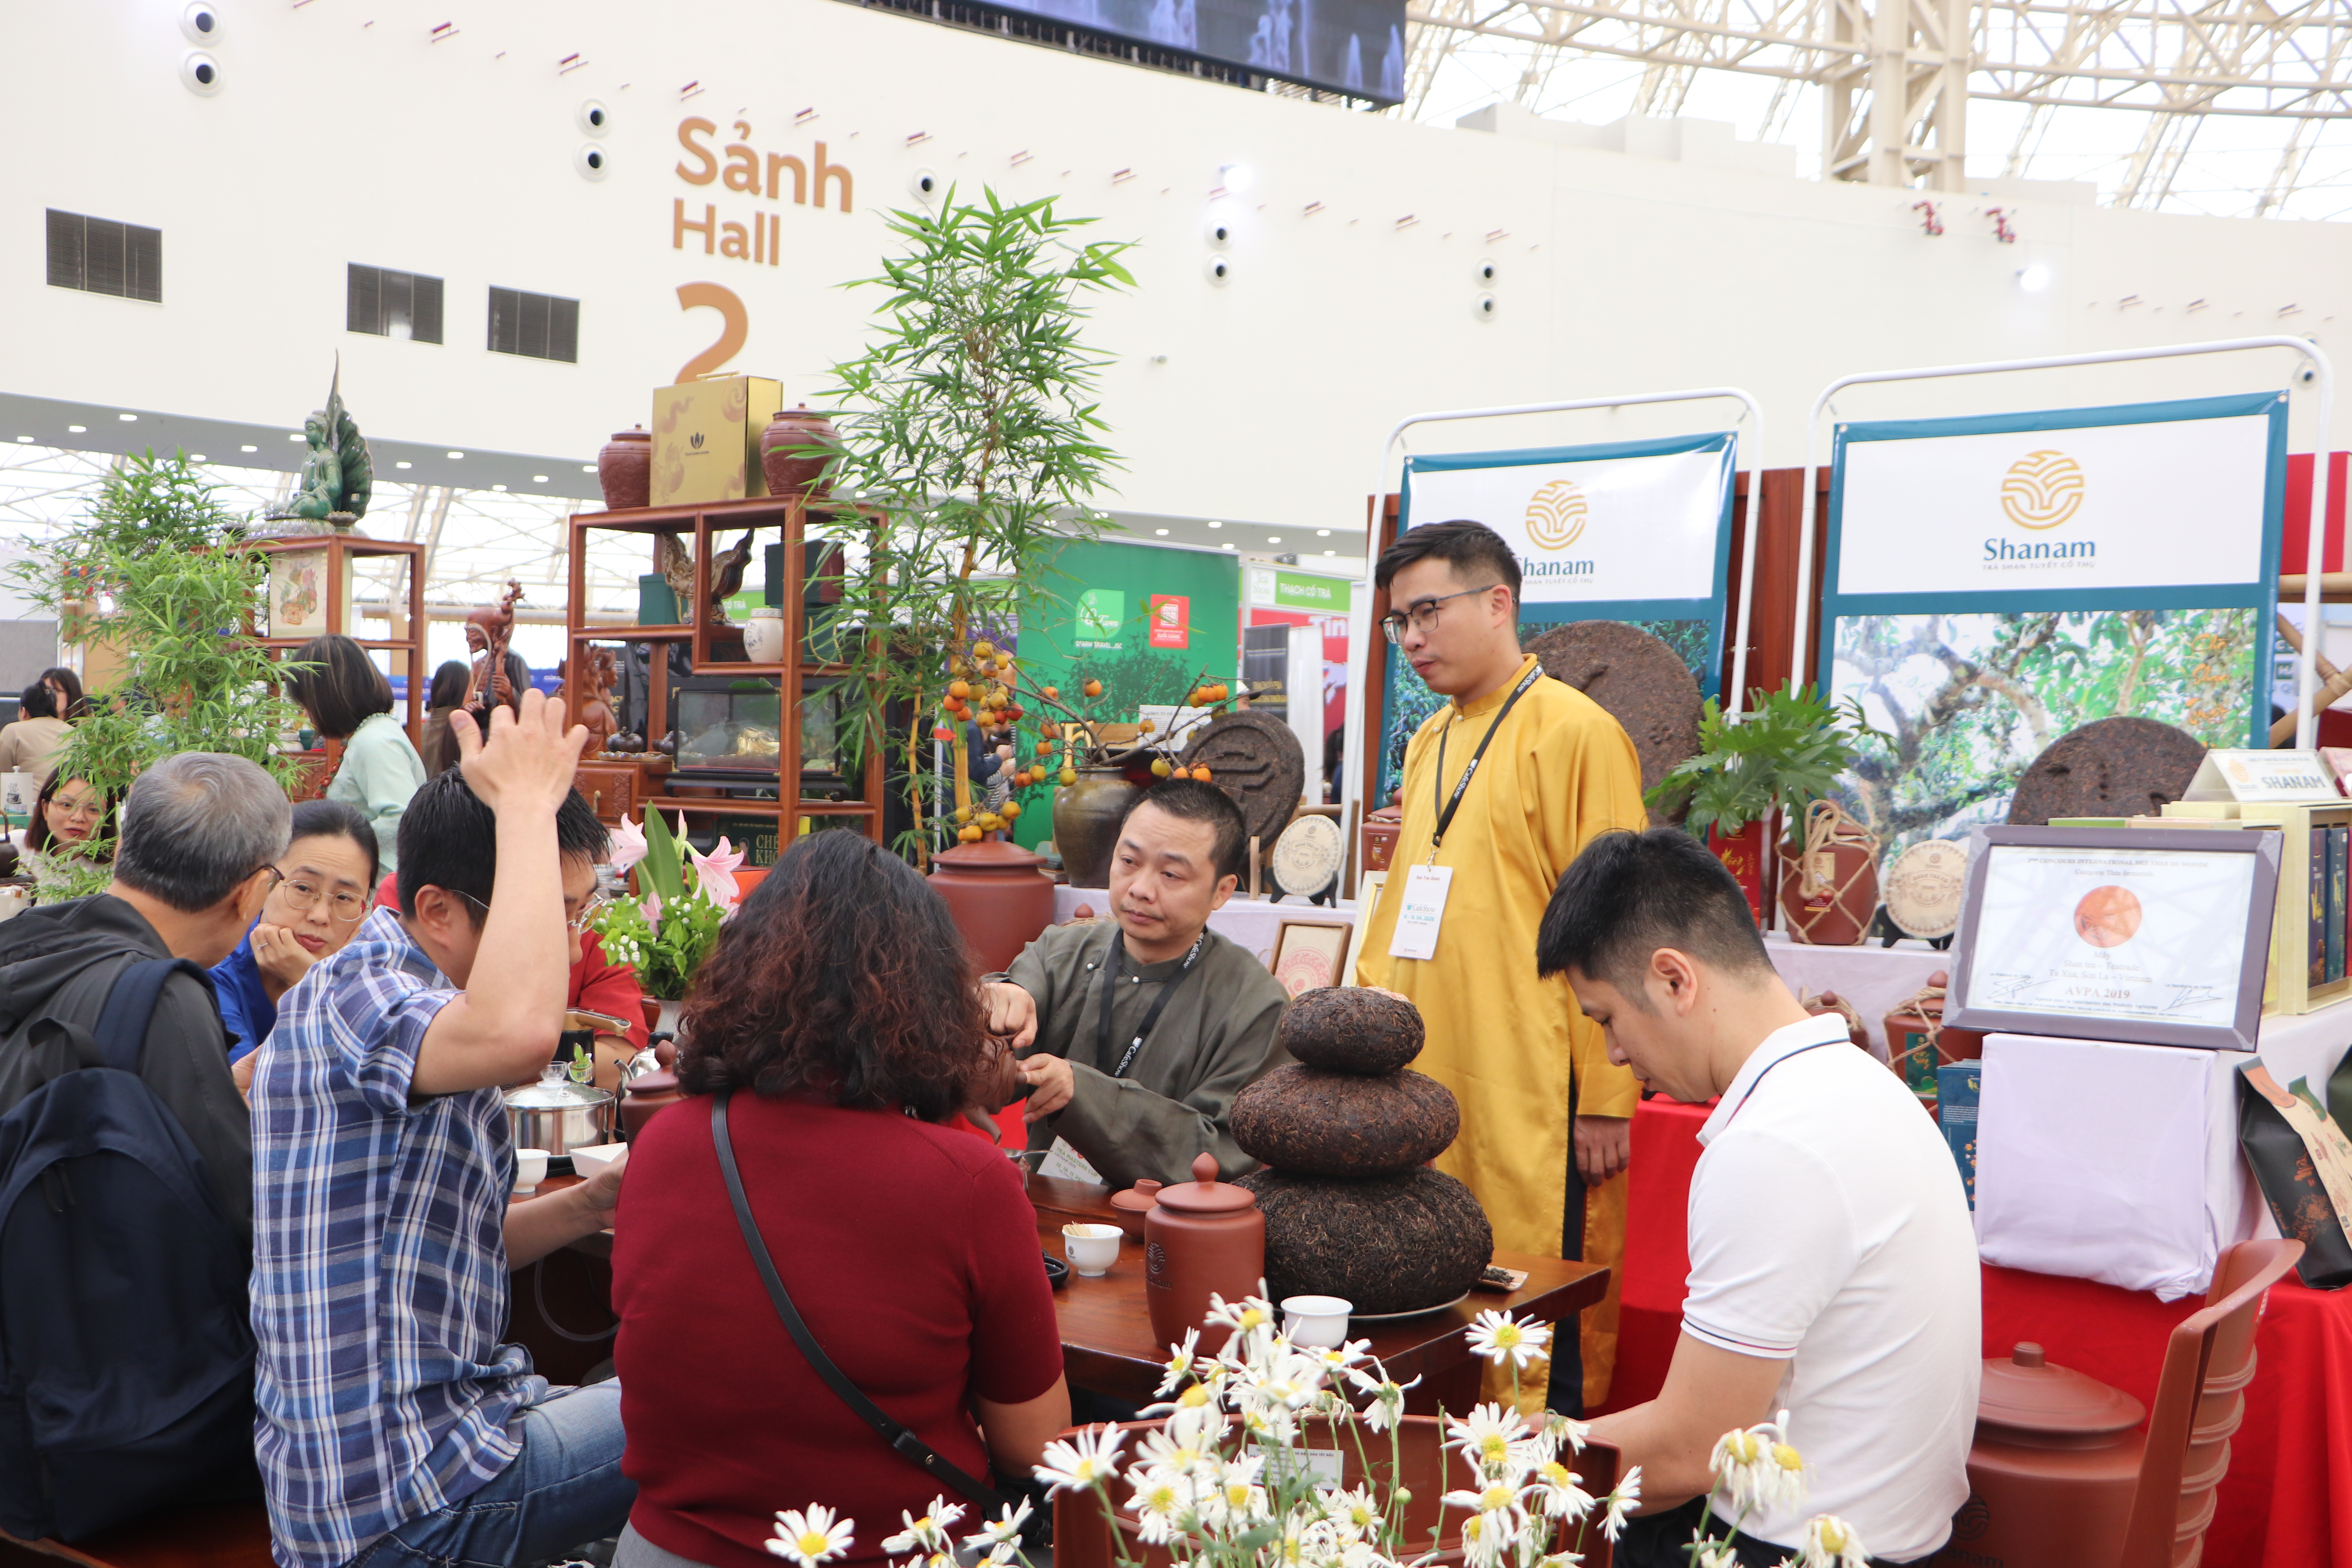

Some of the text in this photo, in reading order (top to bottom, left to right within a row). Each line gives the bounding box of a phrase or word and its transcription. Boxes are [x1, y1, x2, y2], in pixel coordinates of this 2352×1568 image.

[675, 115, 853, 213] Sảnh
[673, 197, 780, 266] Hall
[674, 280, 749, 385] 2
[1984, 537, 2095, 561] Shanam
[1317, 586, 1331, 599] TRÀ
[1517, 669, 1539, 692] CafeShow
[1454, 768, 1473, 799] CafeShow
[2261, 775, 2326, 788] SHANAM
[1413, 903, 1436, 912] CafeShow
[1183, 939, 1202, 968] CafeShow
[2105, 962, 2140, 971] Teatrade
[2118, 973, 2152, 982] Vietnam
[2065, 986, 2131, 998] AVPA 2019
[1114, 1046, 1136, 1077] CafeShow
[1054, 1151, 1068, 1163] VIETNAM
[1056, 1147, 1098, 1177] TEA MASTERS CUP
